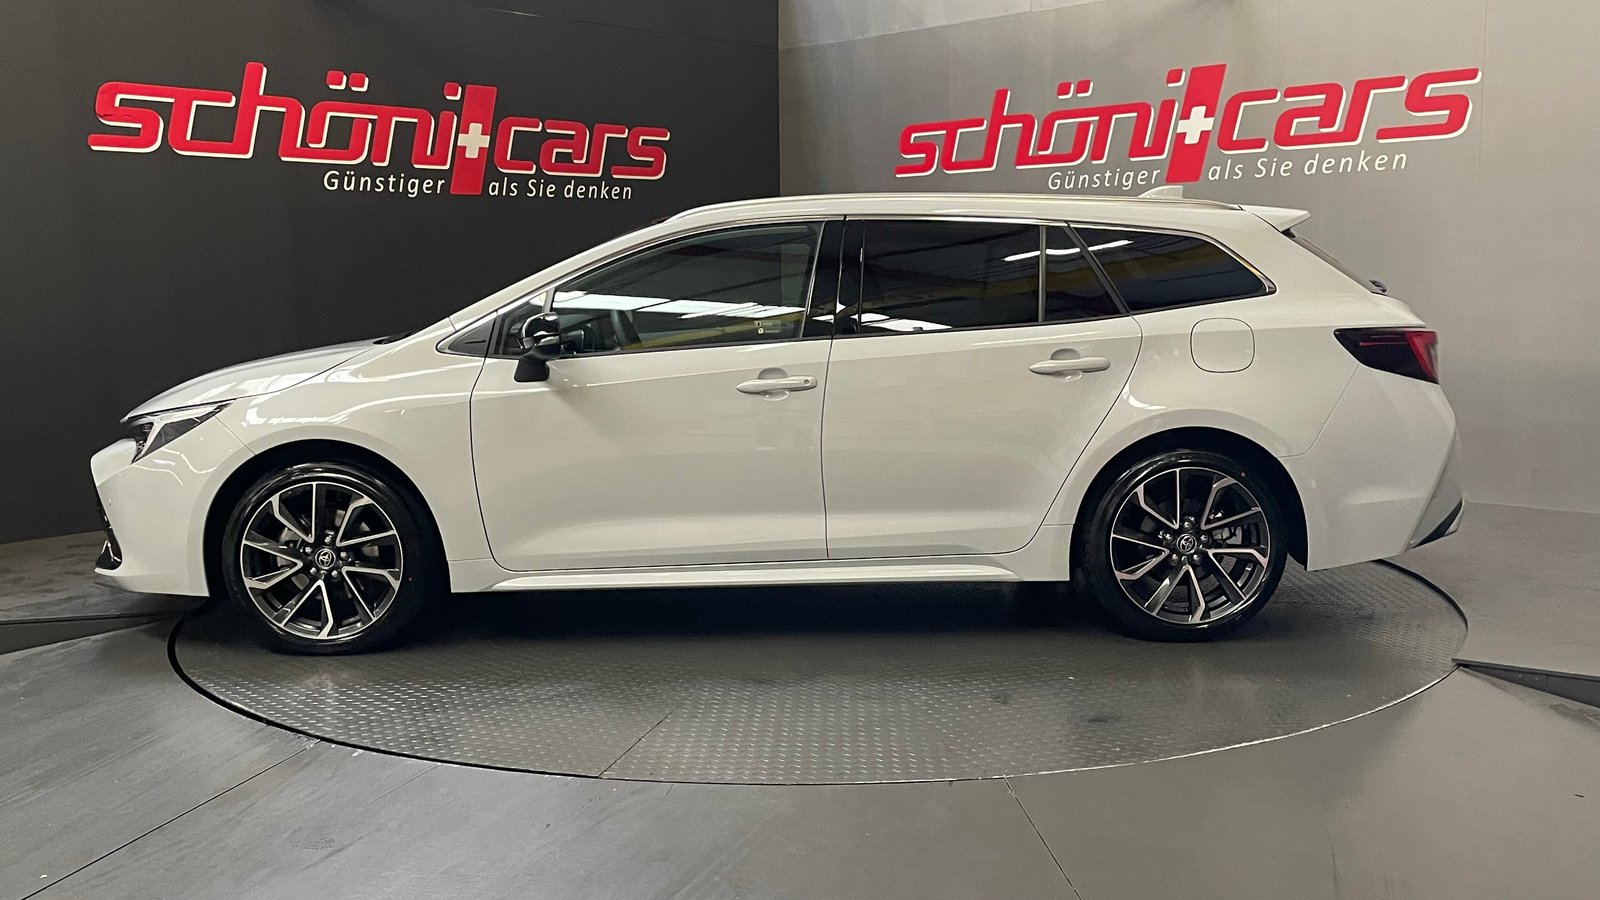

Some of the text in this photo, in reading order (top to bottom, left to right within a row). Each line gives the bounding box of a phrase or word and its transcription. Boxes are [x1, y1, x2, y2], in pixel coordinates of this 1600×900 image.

[1217, 67, 1483, 151] cars
[493, 116, 672, 179] cars
[1047, 150, 1408, 191] Günstiger als Sie denken
[322, 170, 633, 200] Günstiger als Sie denken
